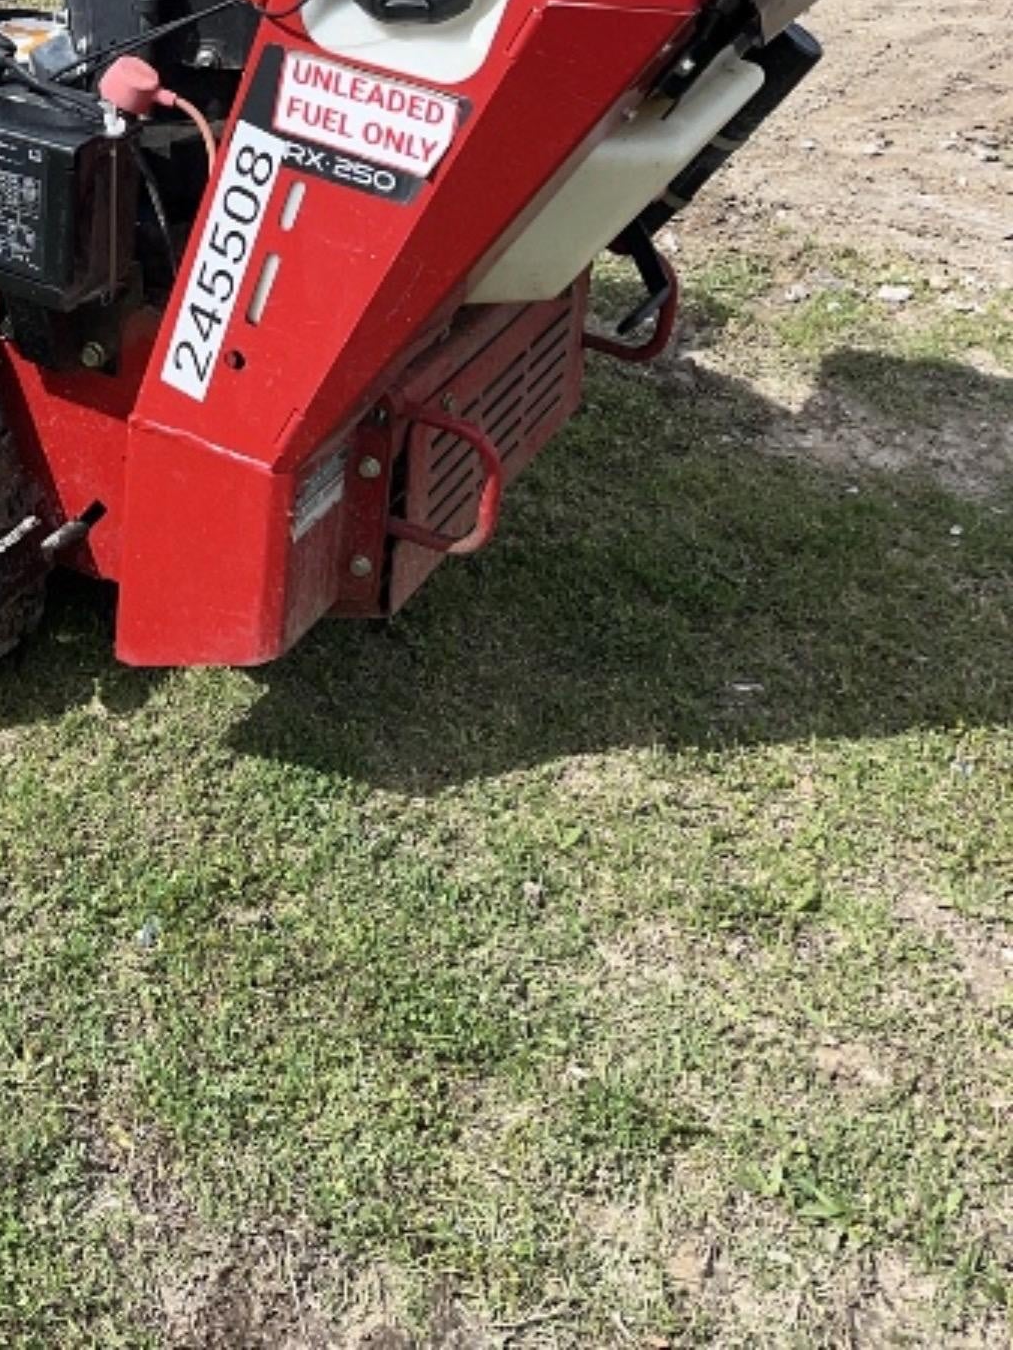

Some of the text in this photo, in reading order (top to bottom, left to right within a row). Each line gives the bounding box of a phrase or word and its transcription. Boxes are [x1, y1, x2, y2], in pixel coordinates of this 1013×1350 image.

[292, 59, 444, 124] UNLEADED
[287, 96, 439, 163] FUEL ONLY
[174, 145, 274, 382] 245508
